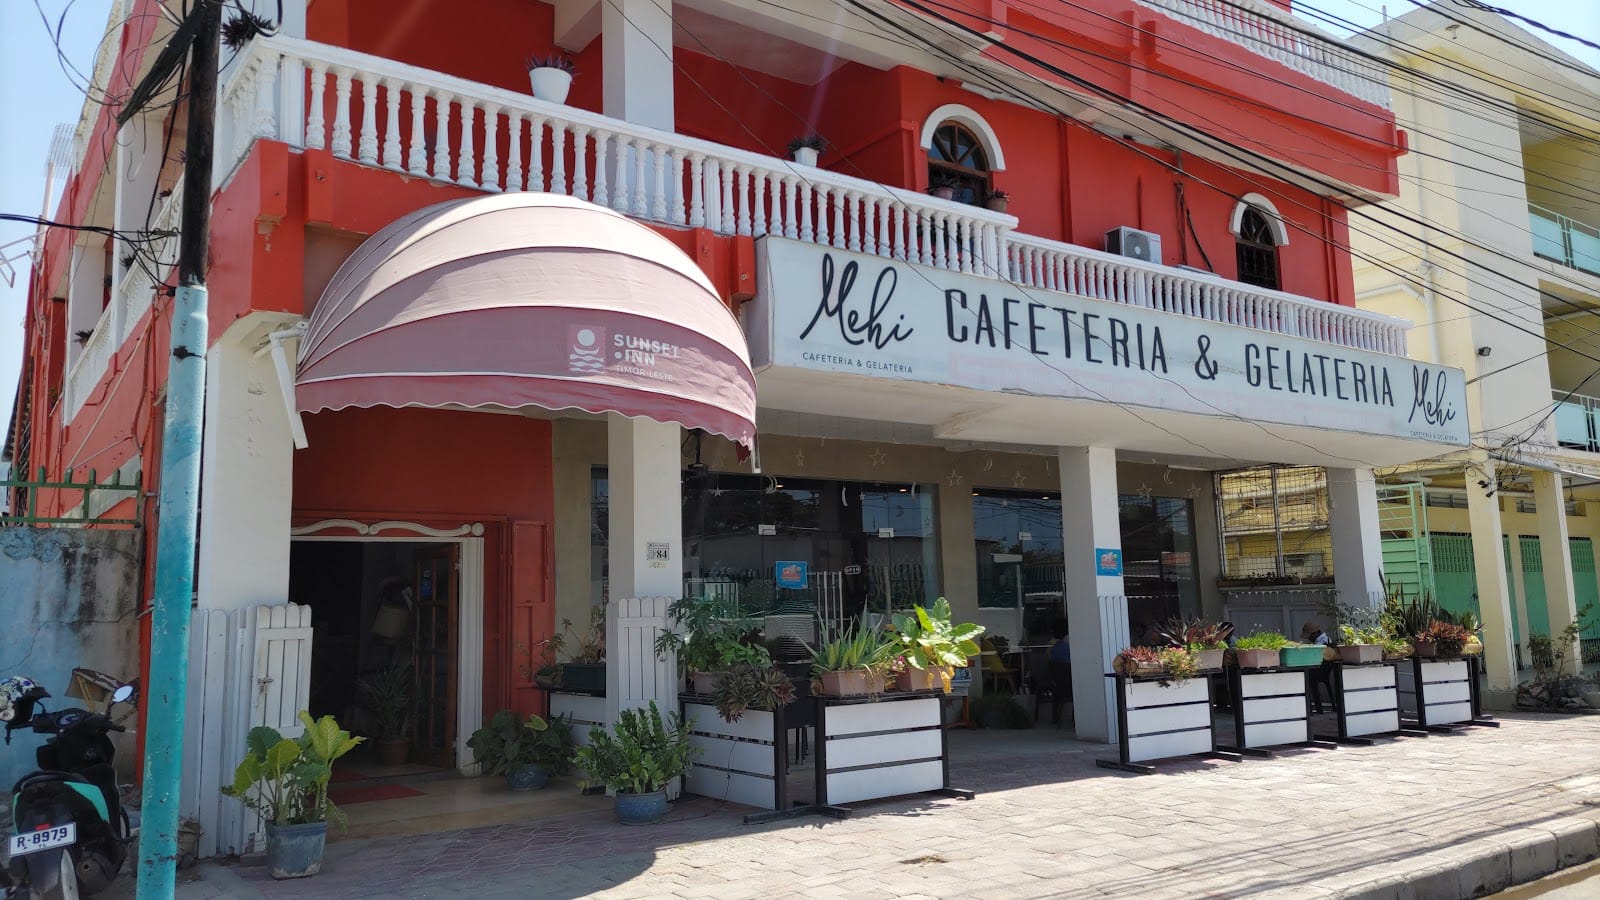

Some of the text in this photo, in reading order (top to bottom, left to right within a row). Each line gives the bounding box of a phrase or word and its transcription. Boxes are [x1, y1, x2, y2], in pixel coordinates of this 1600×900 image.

[800, 253, 914, 349] Mehi
[614, 334, 679, 357] SUNSET
[945, 289, 1394, 407] CAFETERIA & GELATERIA
[802, 352, 853, 366] CAFETERIA
[866, 360, 913, 374] GELATERIA
[1408, 365, 1455, 427] Mehi
[656, 549, 667, 558] 84
[17, 827, 68, 847] R-8979
